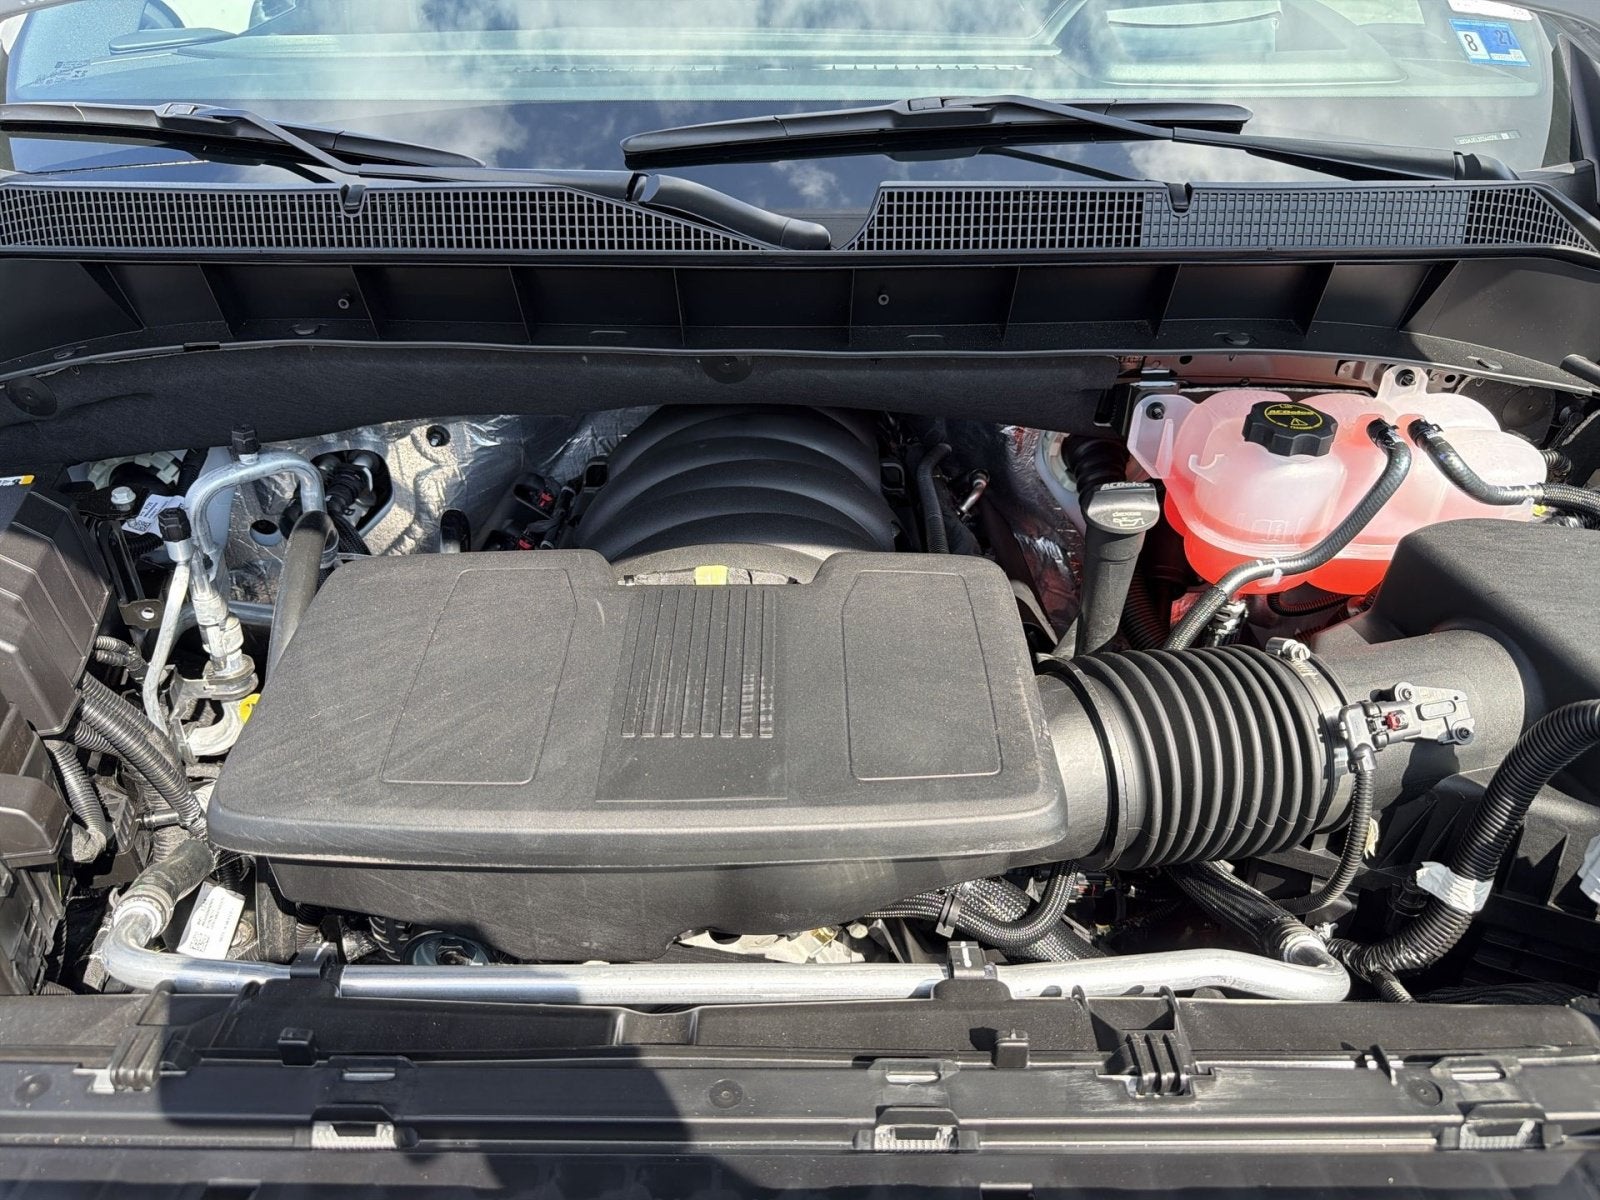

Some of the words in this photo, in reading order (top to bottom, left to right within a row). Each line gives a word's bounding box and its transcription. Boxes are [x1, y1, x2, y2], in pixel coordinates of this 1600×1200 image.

[1464, 34, 1478, 51] 8
[1495, 30, 1513, 45] 27
[1100, 481, 1151, 491] ACDelco
